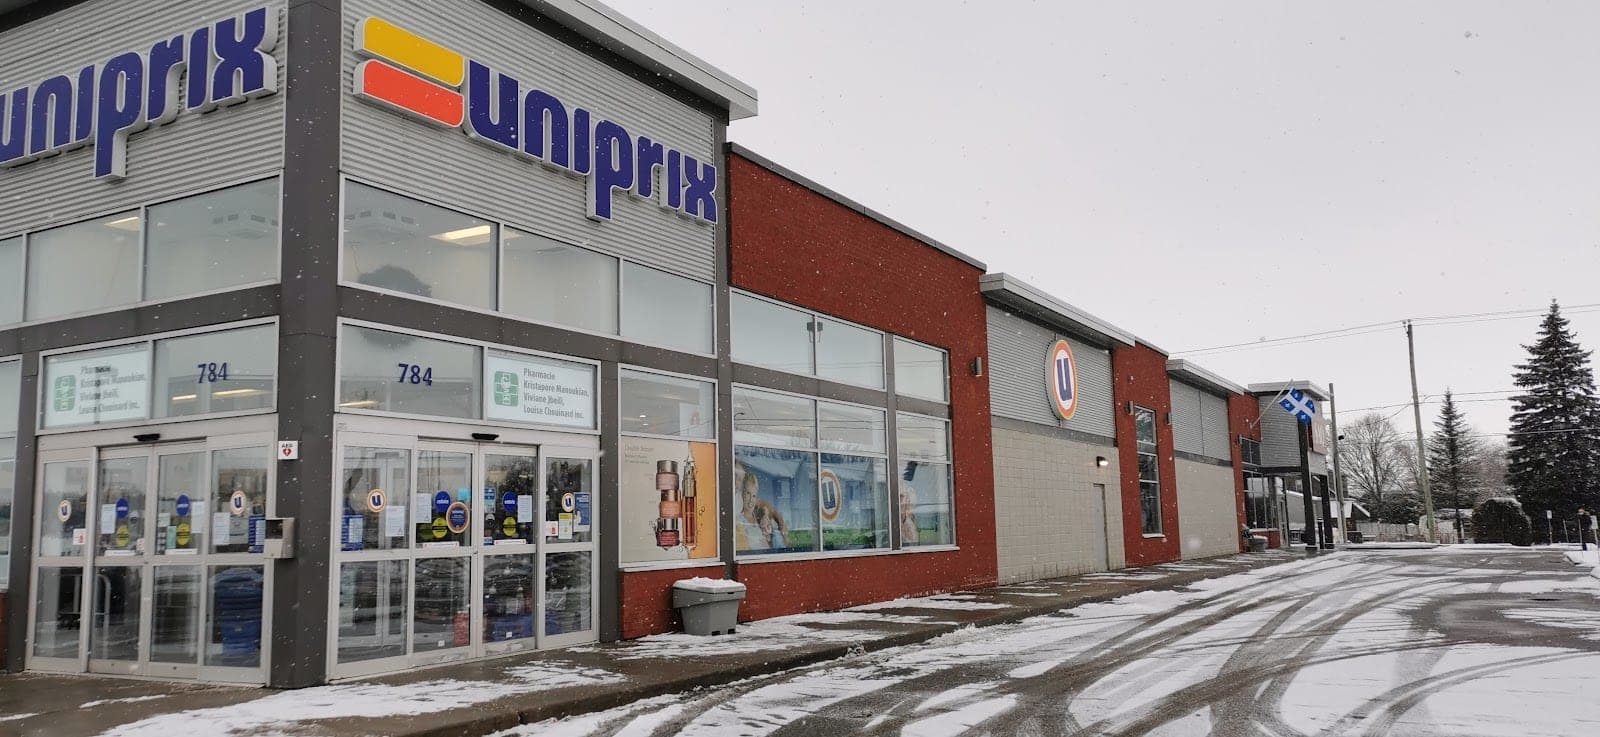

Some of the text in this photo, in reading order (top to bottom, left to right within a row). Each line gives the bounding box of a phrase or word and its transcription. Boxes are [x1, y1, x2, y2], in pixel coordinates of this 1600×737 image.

[0, 6, 271, 179] uniprix
[466, 58, 718, 223] uniprix
[197, 362, 227, 384] 784
[398, 363, 432, 386] 784
[523, 367, 556, 380] Pharmacie
[523, 404, 545, 414] Louise
